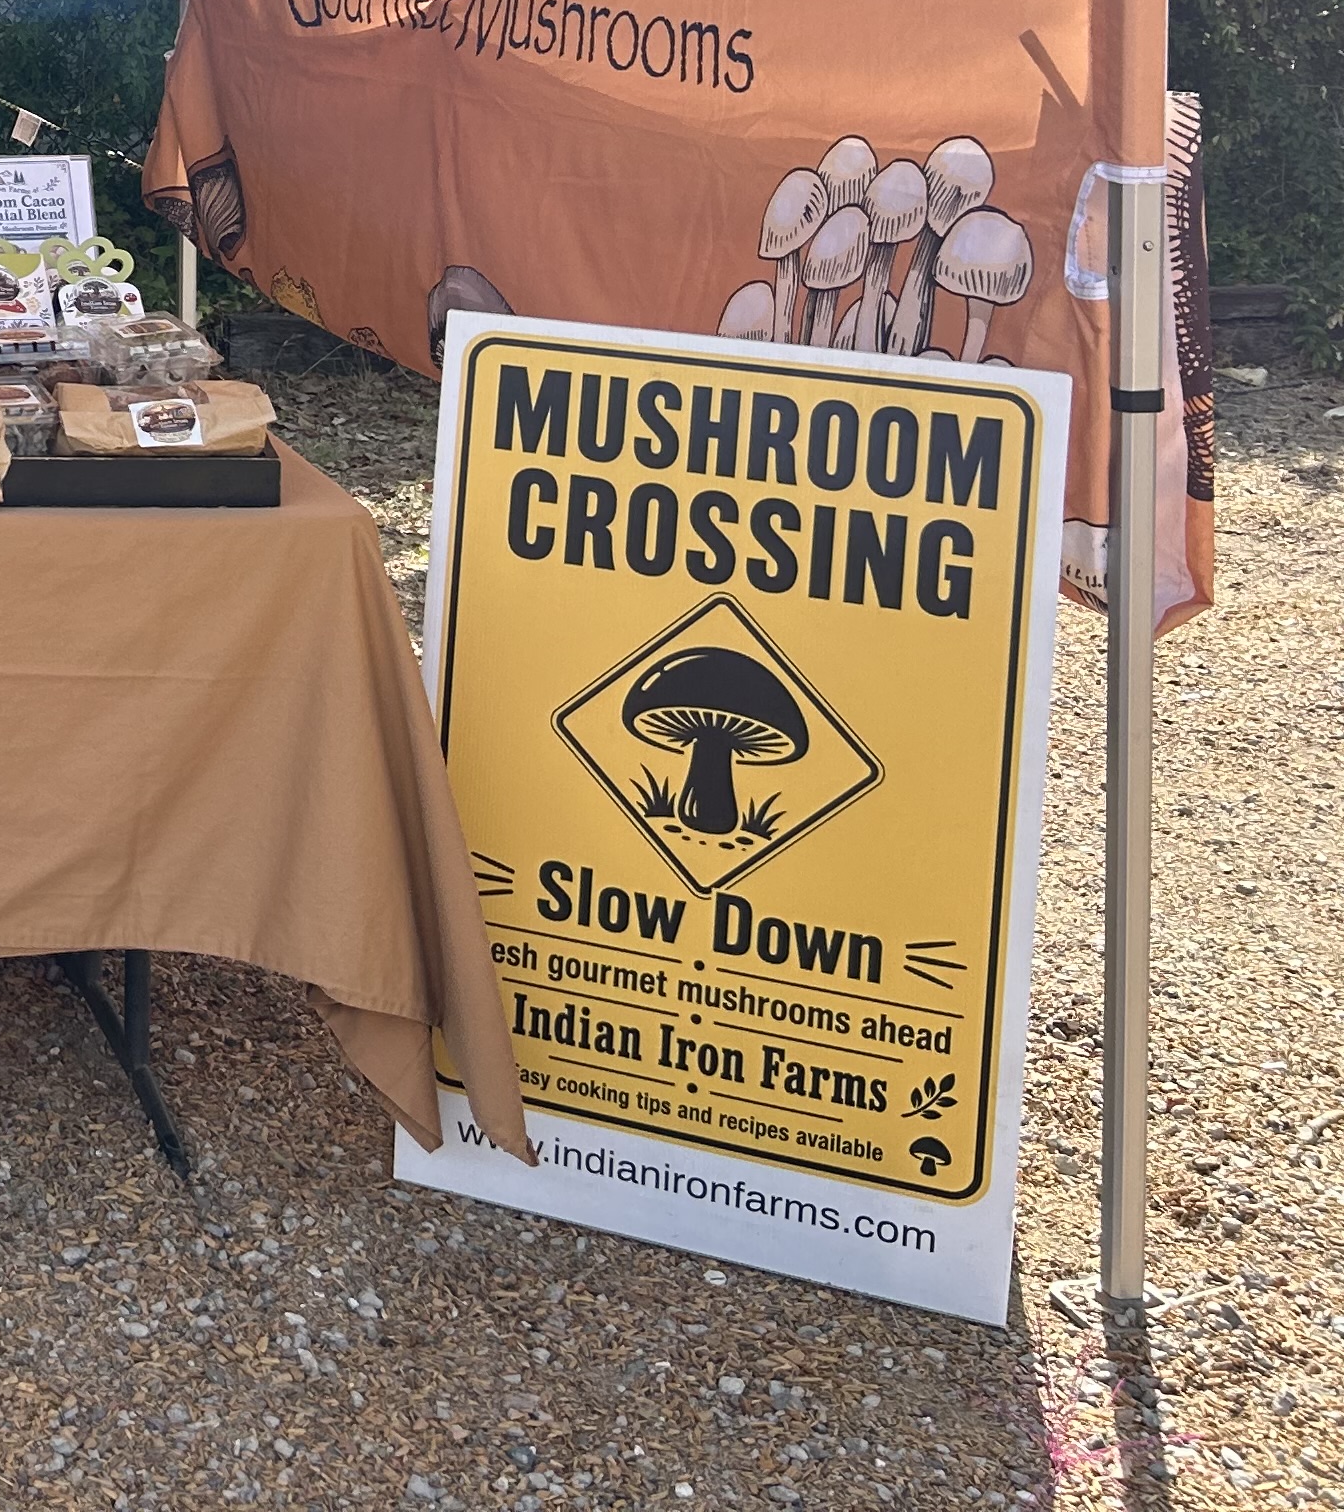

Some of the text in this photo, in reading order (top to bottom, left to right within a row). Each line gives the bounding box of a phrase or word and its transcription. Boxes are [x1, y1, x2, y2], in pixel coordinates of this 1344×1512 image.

[21, 195, 64, 207] Cacao
[28, 208, 66, 220] Blend
[494, 364, 1003, 510] MUSHROOM
[507, 468, 975, 620] CROSSING
[537, 860, 883, 984] Slow Down
[490, 942, 952, 1054] esh gourmet mushrooms ahead
[512, 993, 887, 1114] Indian Iron Farms
[519, 1067, 884, 1164] asy cooking tips and recipes available
[456, 1119, 936, 1253] w.indianironfarms.com
